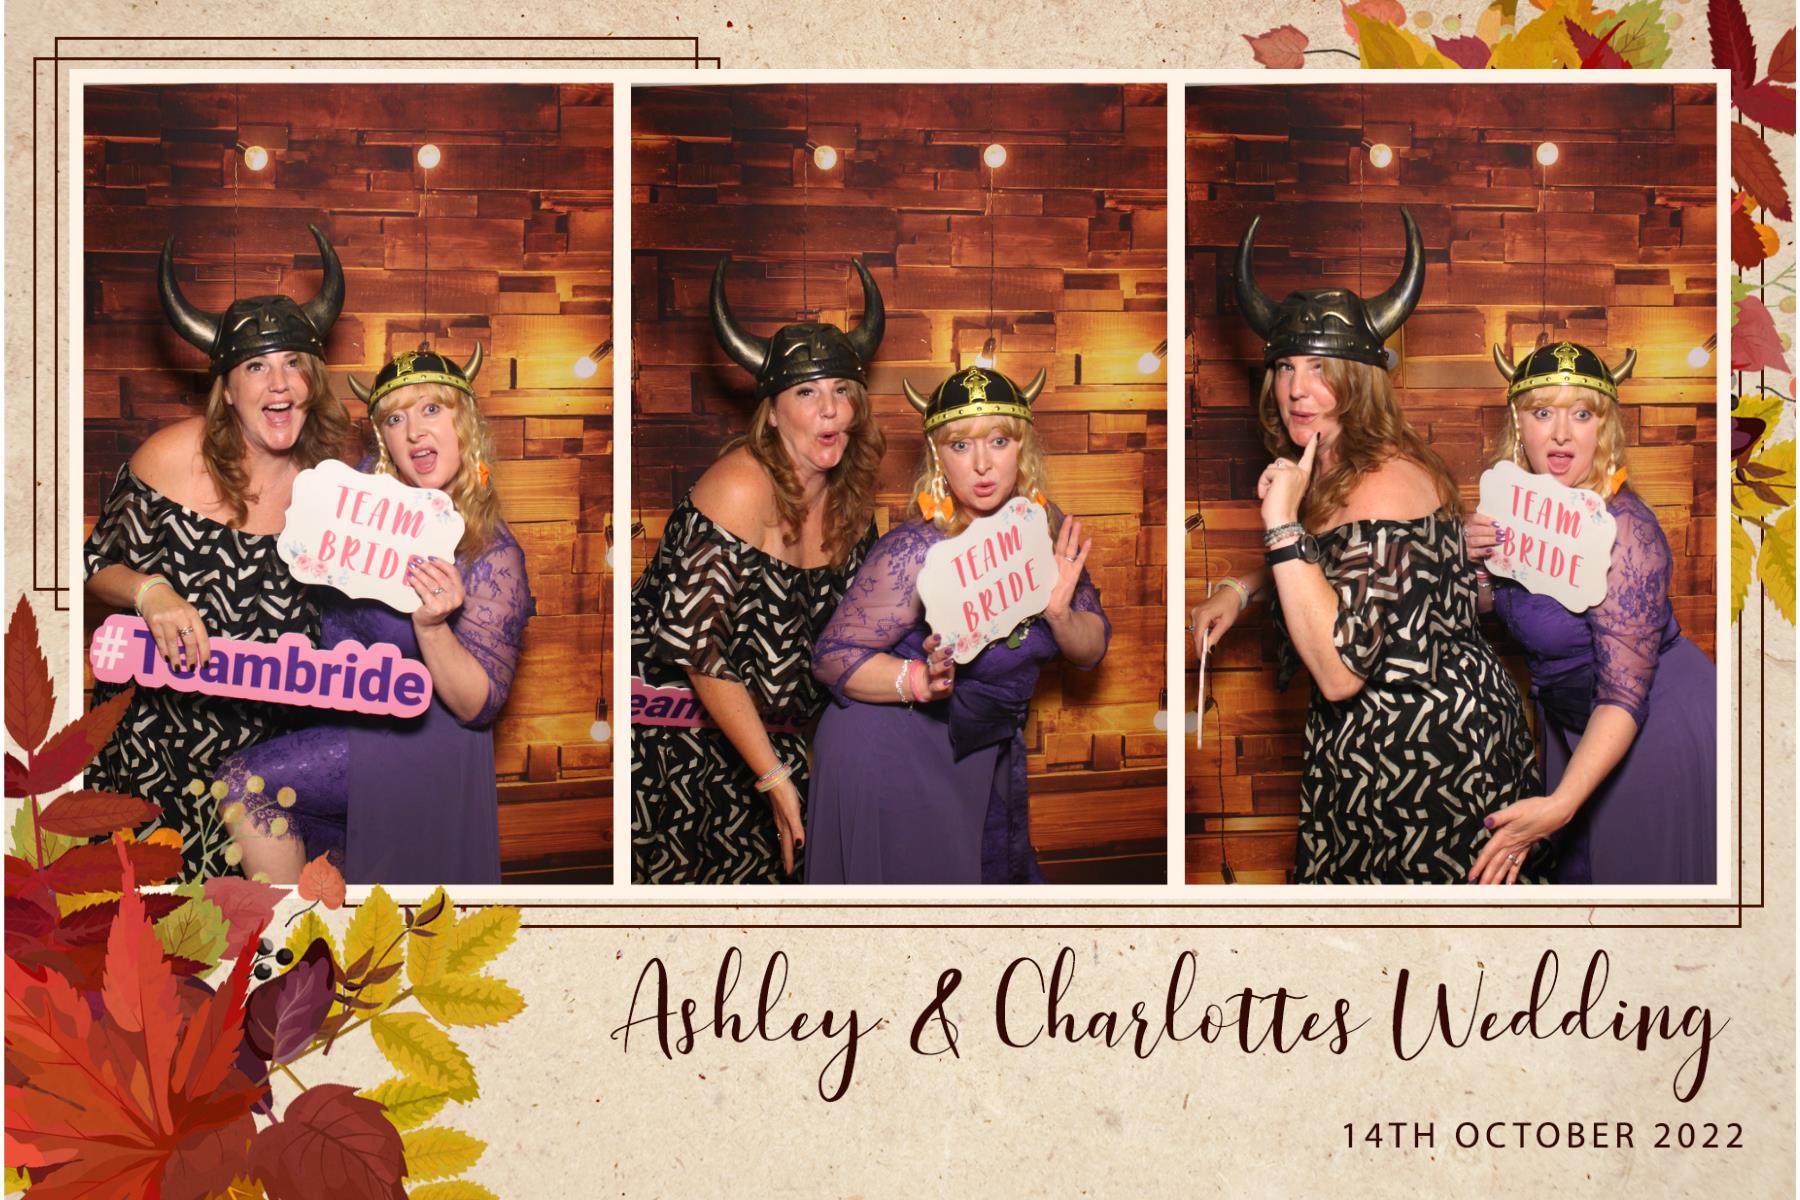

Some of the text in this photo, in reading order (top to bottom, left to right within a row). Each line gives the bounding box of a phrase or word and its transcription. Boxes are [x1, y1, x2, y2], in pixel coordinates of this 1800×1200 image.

[336, 485, 425, 539] TEAM
[1512, 484, 1582, 539] TEAM
[951, 524, 1022, 588] TEAM
[1503, 526, 1584, 588] BRIDE
[962, 557, 1040, 633] BRIDE
